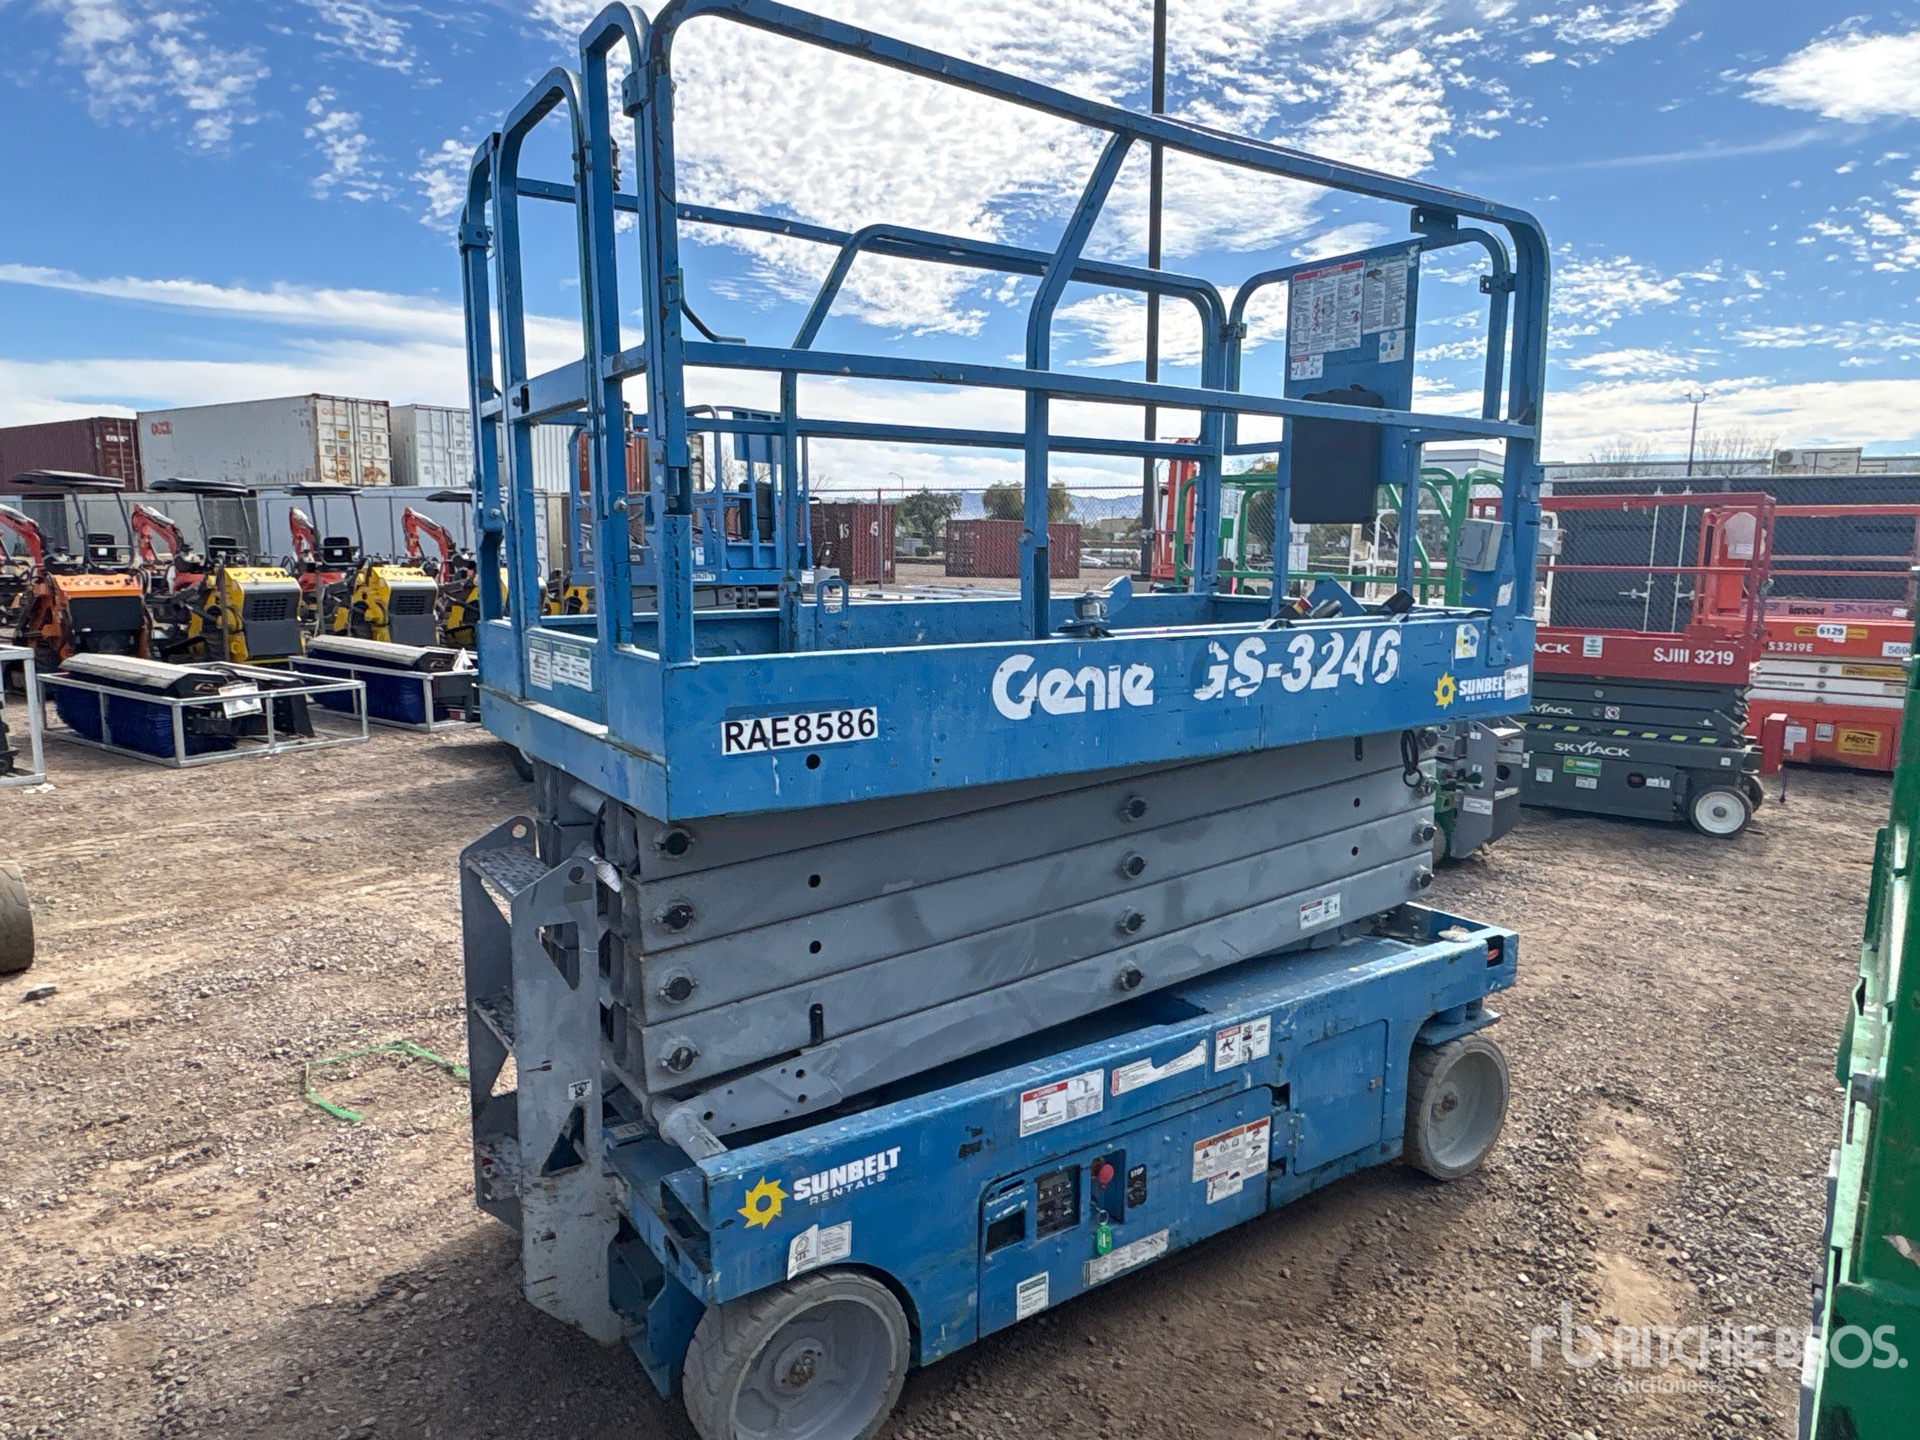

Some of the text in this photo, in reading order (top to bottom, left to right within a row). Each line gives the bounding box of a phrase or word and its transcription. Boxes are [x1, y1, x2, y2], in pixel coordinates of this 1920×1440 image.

[1819, 626, 1844, 637] 6129
[1653, 647, 1735, 666] SJIII 3219
[991, 653, 1155, 721] Genie
[1458, 675, 1505, 697] SUNBEL
[1465, 691, 1502, 702] RENTALS
[724, 708, 876, 753] RAE8586
[1553, 740, 1631, 758] SKYJACK
[793, 1146, 902, 1201] SUNBELT
[808, 1172, 887, 1206] RENTALS
